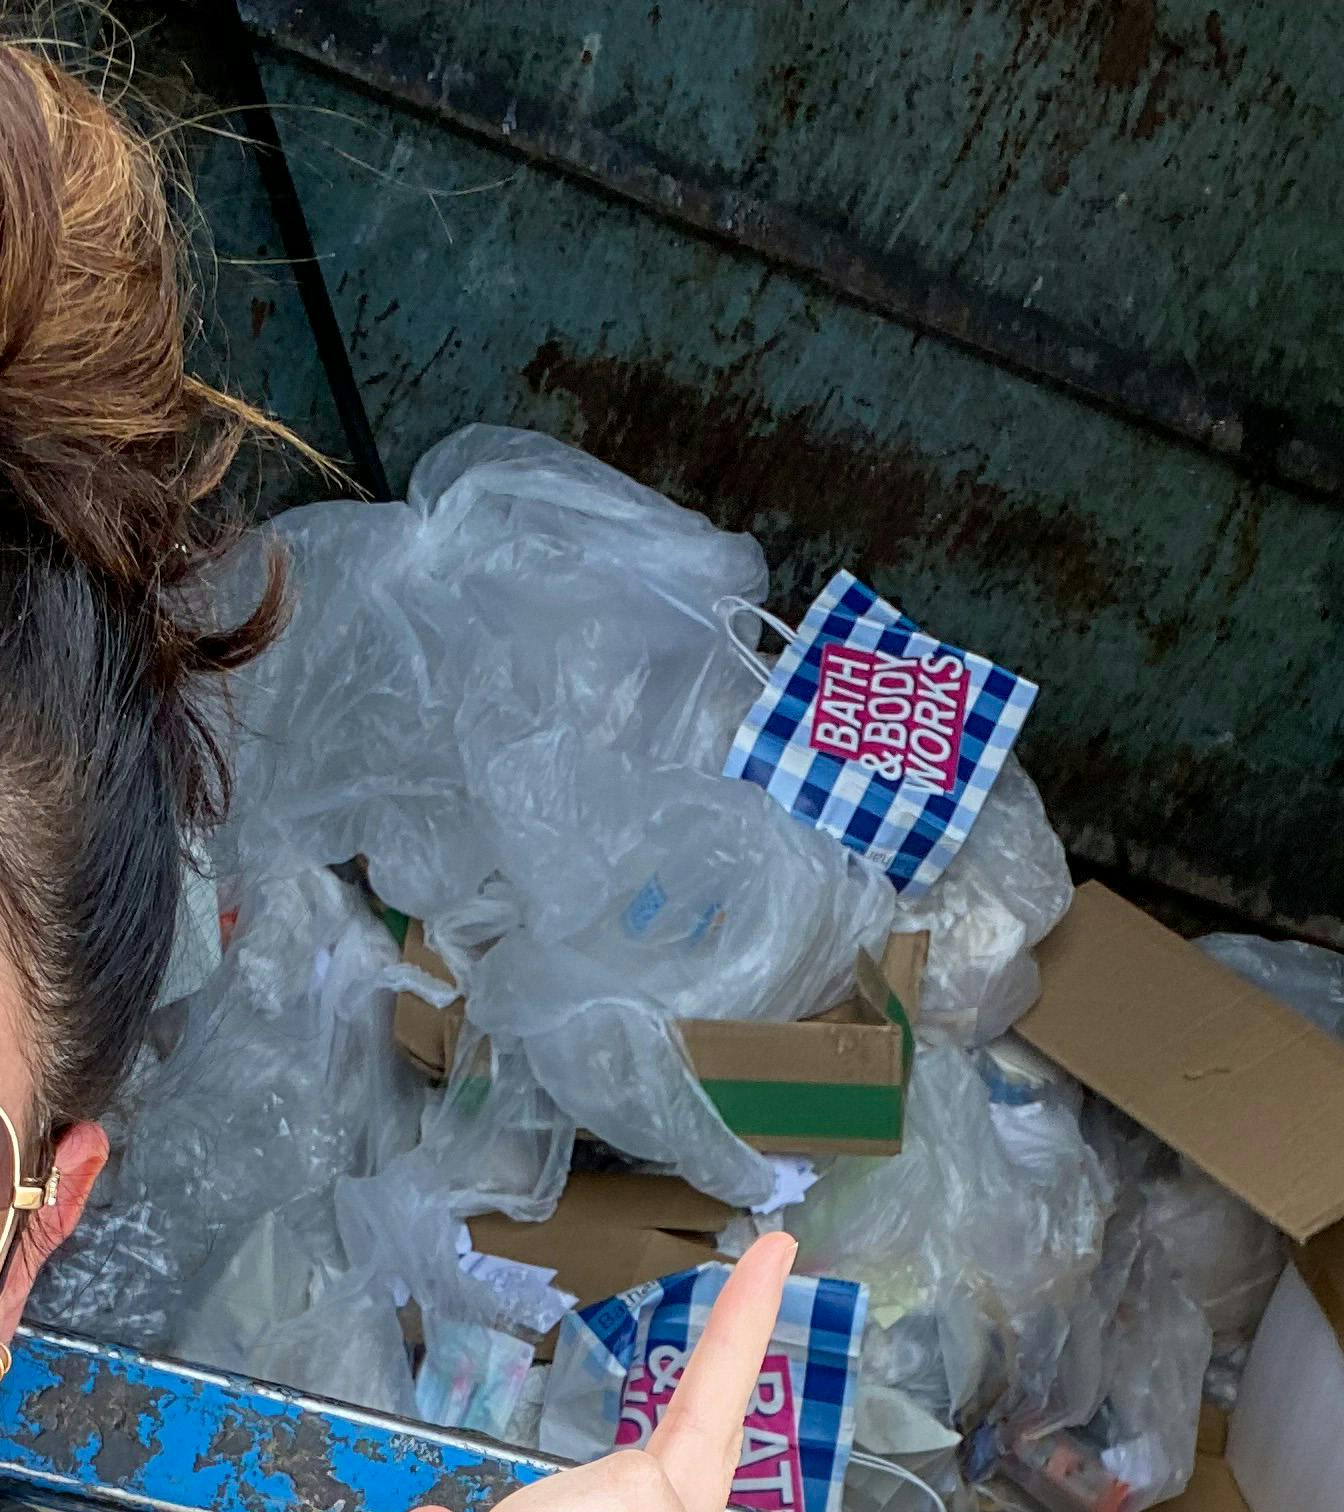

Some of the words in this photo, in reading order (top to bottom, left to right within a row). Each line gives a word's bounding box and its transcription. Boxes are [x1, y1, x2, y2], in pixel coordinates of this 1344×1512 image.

[815, 654, 870, 753] BATH
[863, 650, 921, 751] BODY
[902, 652, 965, 797] WORKS
